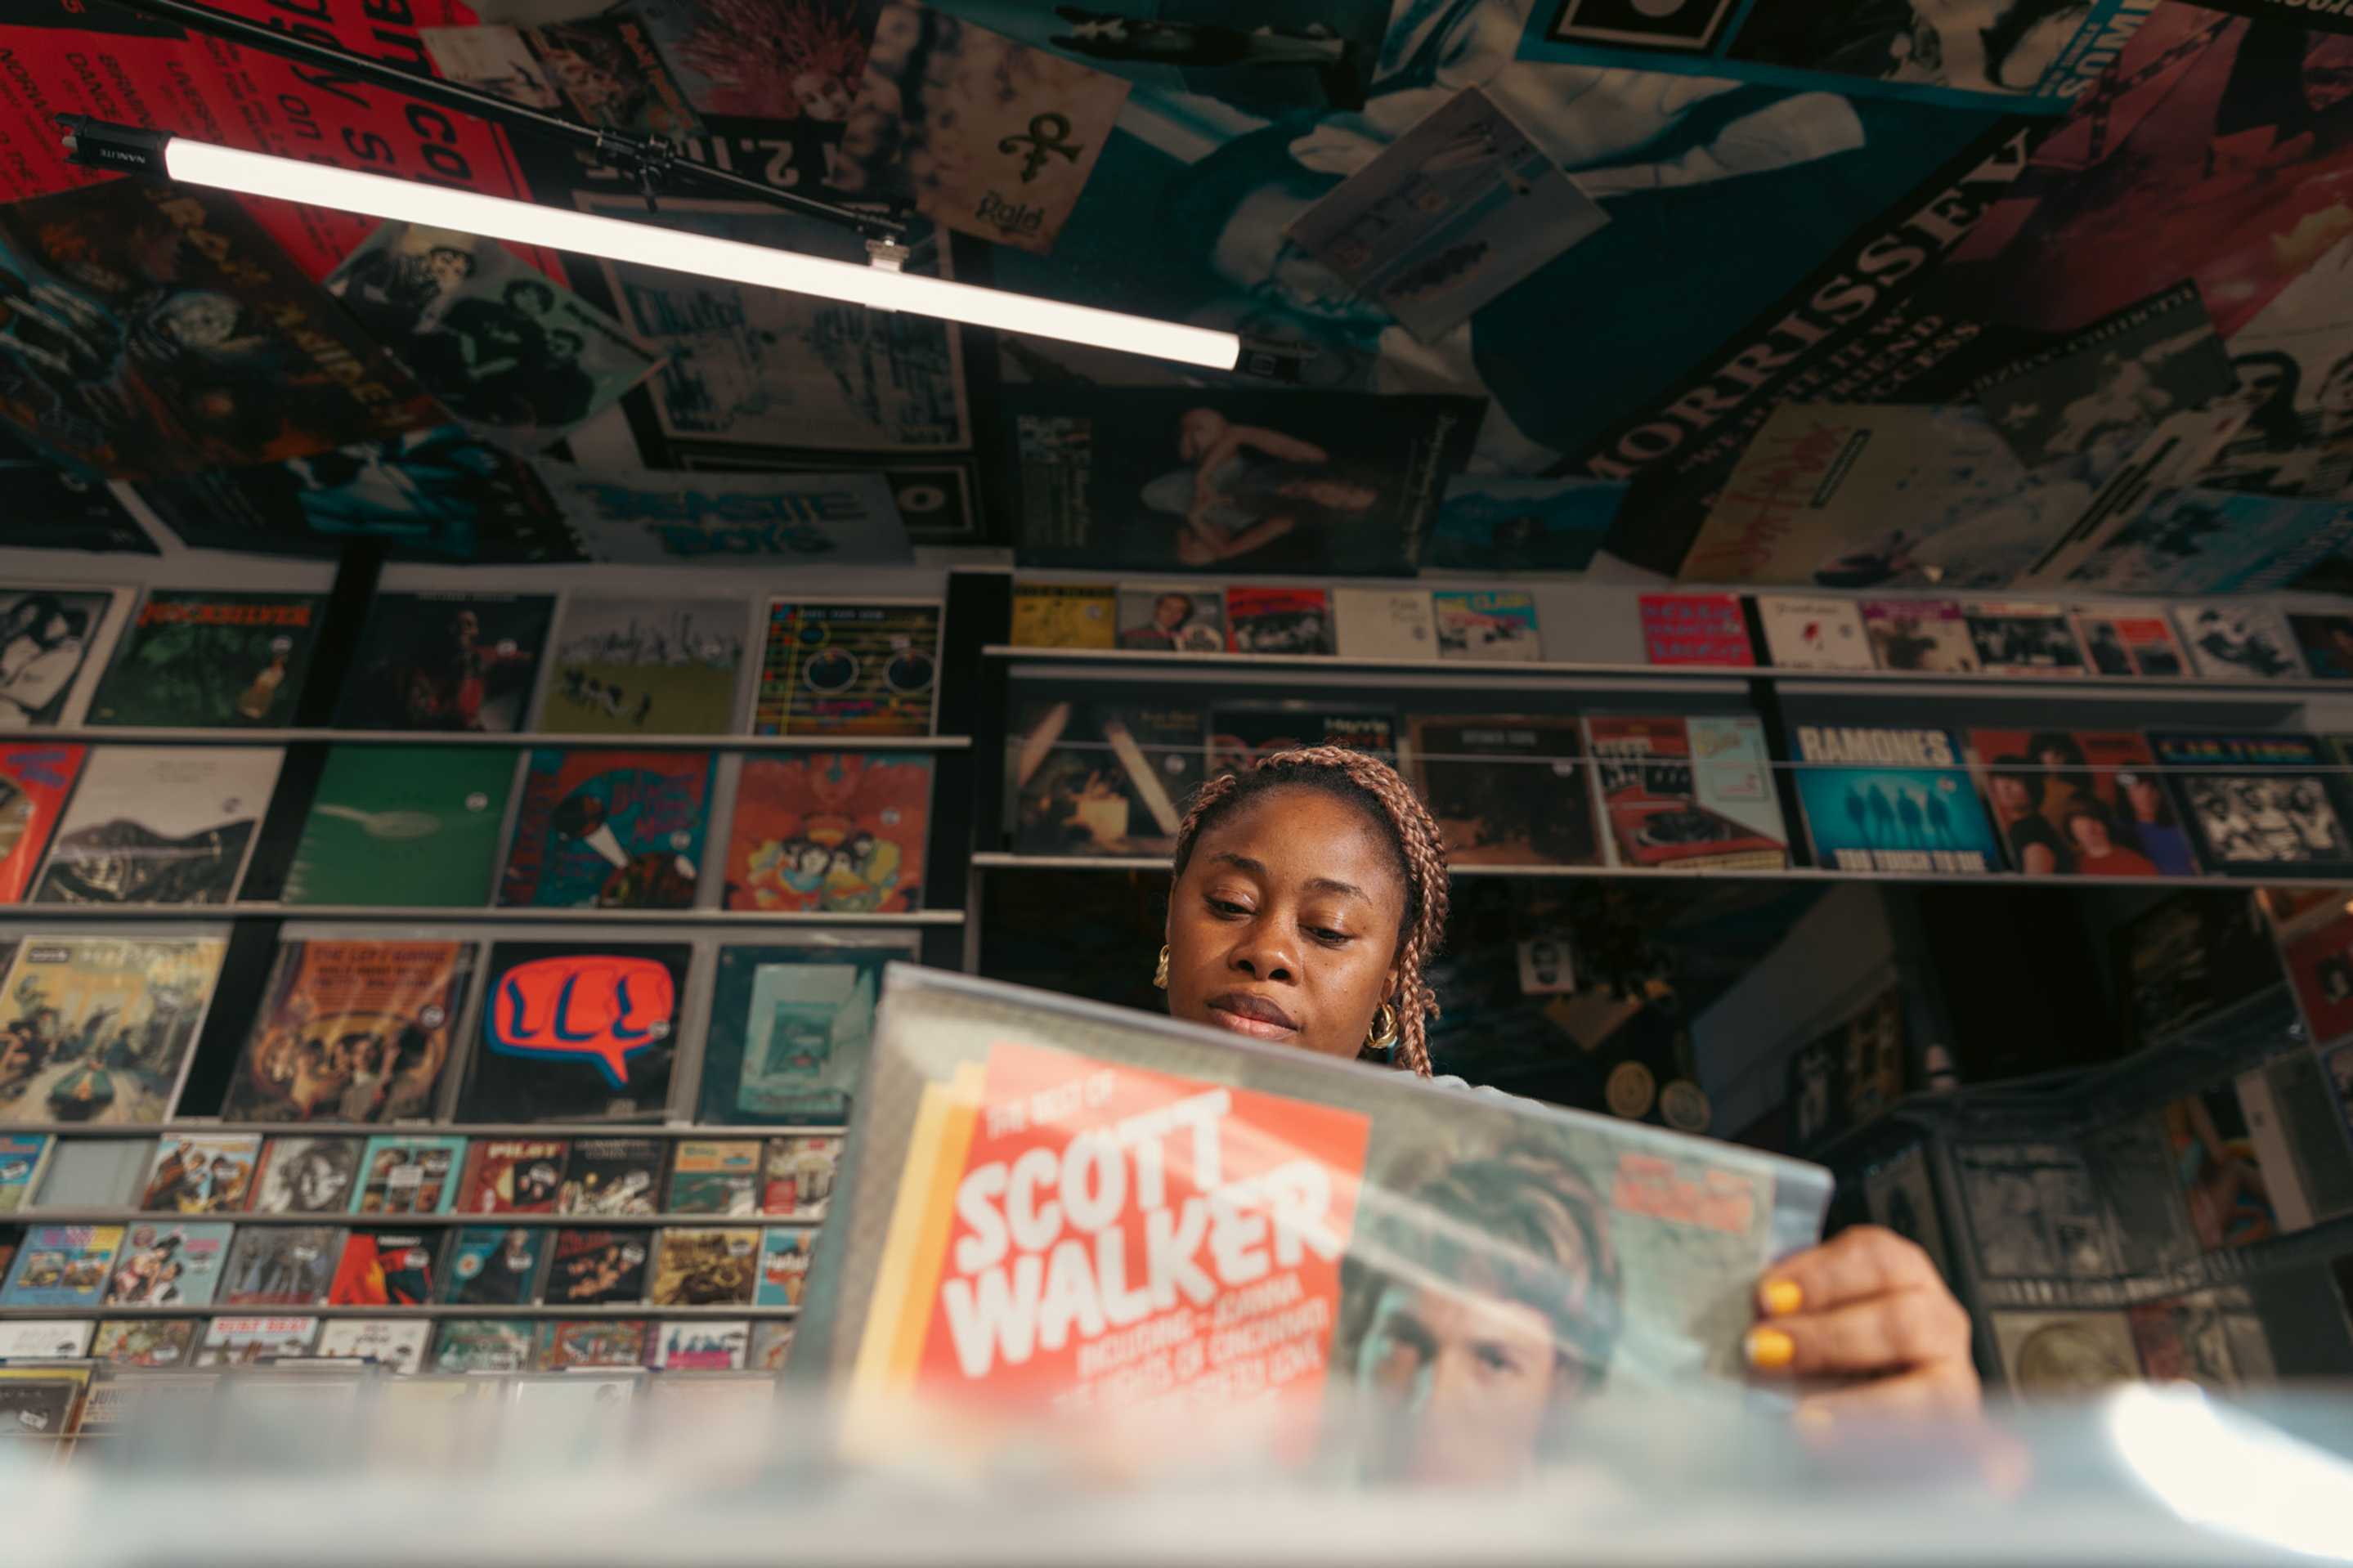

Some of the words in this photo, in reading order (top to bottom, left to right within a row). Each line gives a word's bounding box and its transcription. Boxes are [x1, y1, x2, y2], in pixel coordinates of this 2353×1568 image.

[99, 147, 146, 165] NANLITE
[1798, 726, 1955, 767] RAMONES
[955, 1090, 1231, 1274] SCOTT
[941, 1158, 1347, 1379] WALKER
